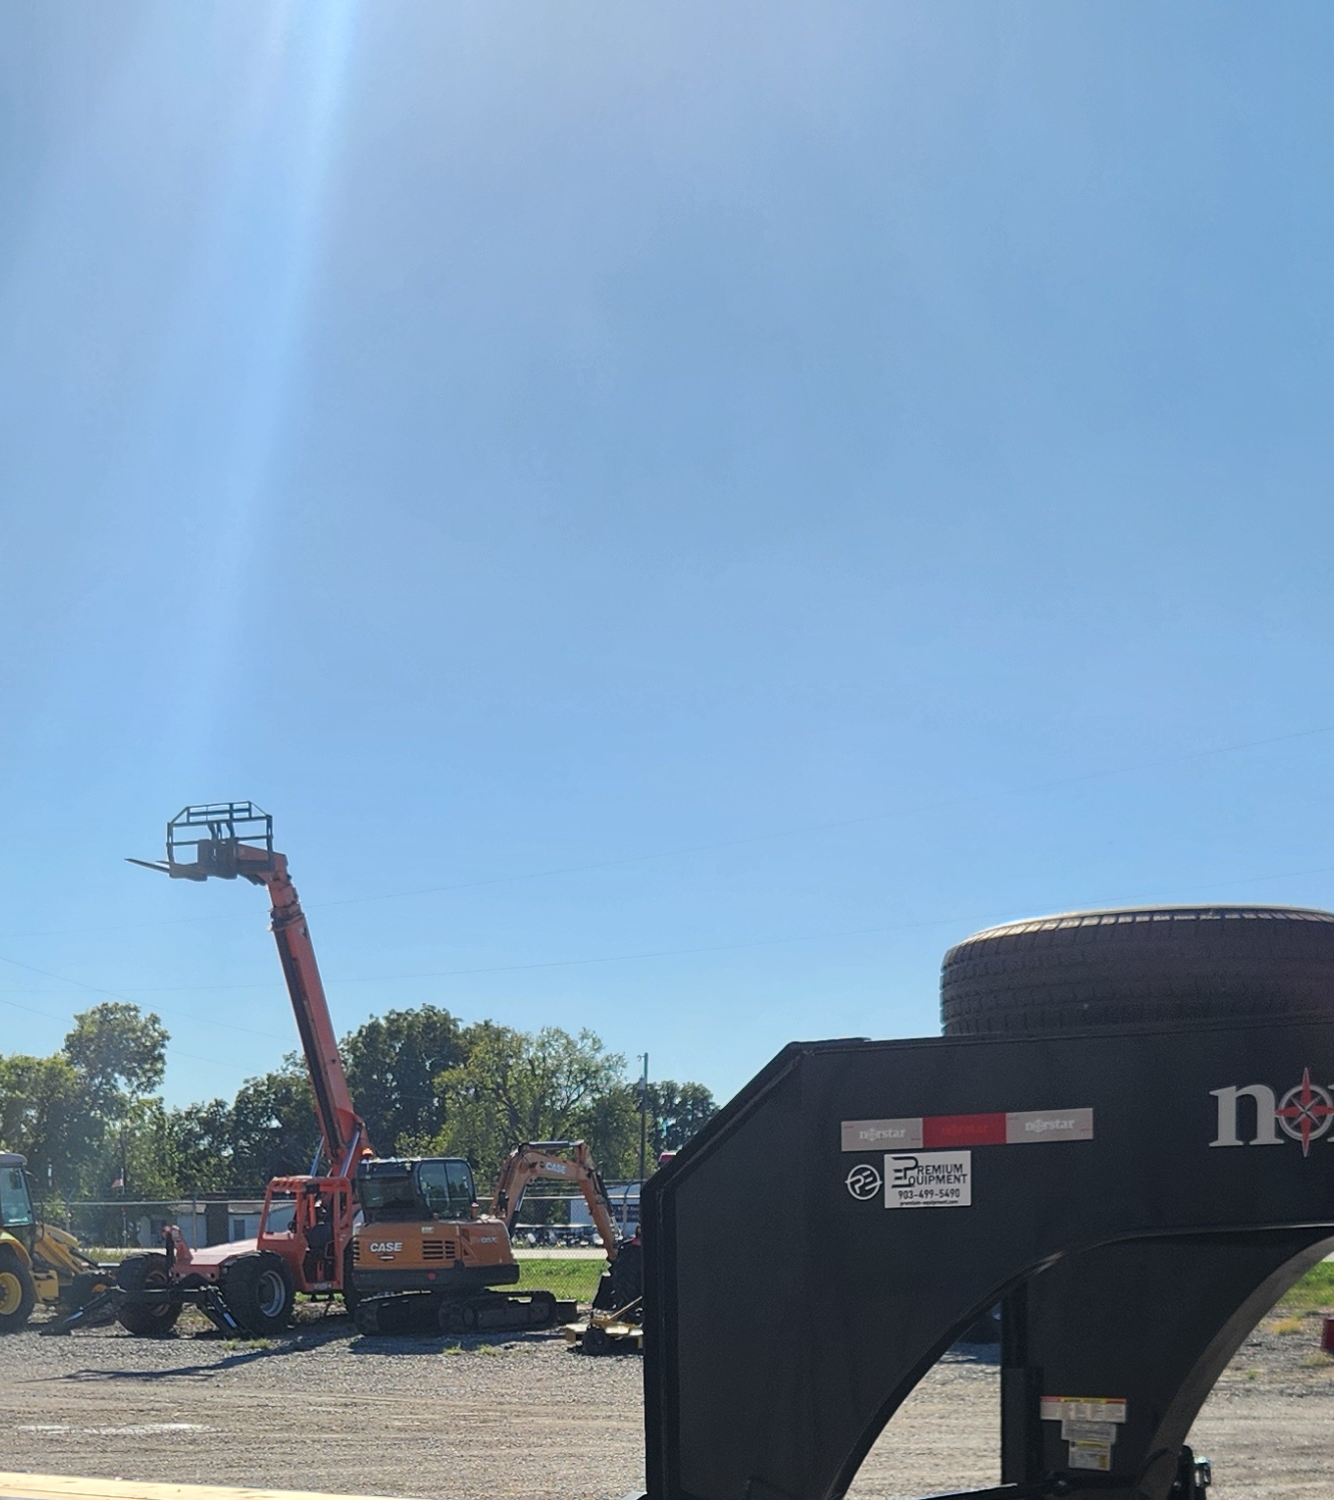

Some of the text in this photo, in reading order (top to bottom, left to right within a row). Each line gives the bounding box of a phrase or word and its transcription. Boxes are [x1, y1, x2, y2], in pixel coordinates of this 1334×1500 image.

[545, 1160, 567, 1175] CASE
[898, 1188, 960, 1200] 903-499-5490
[370, 1241, 404, 1253] CASE
